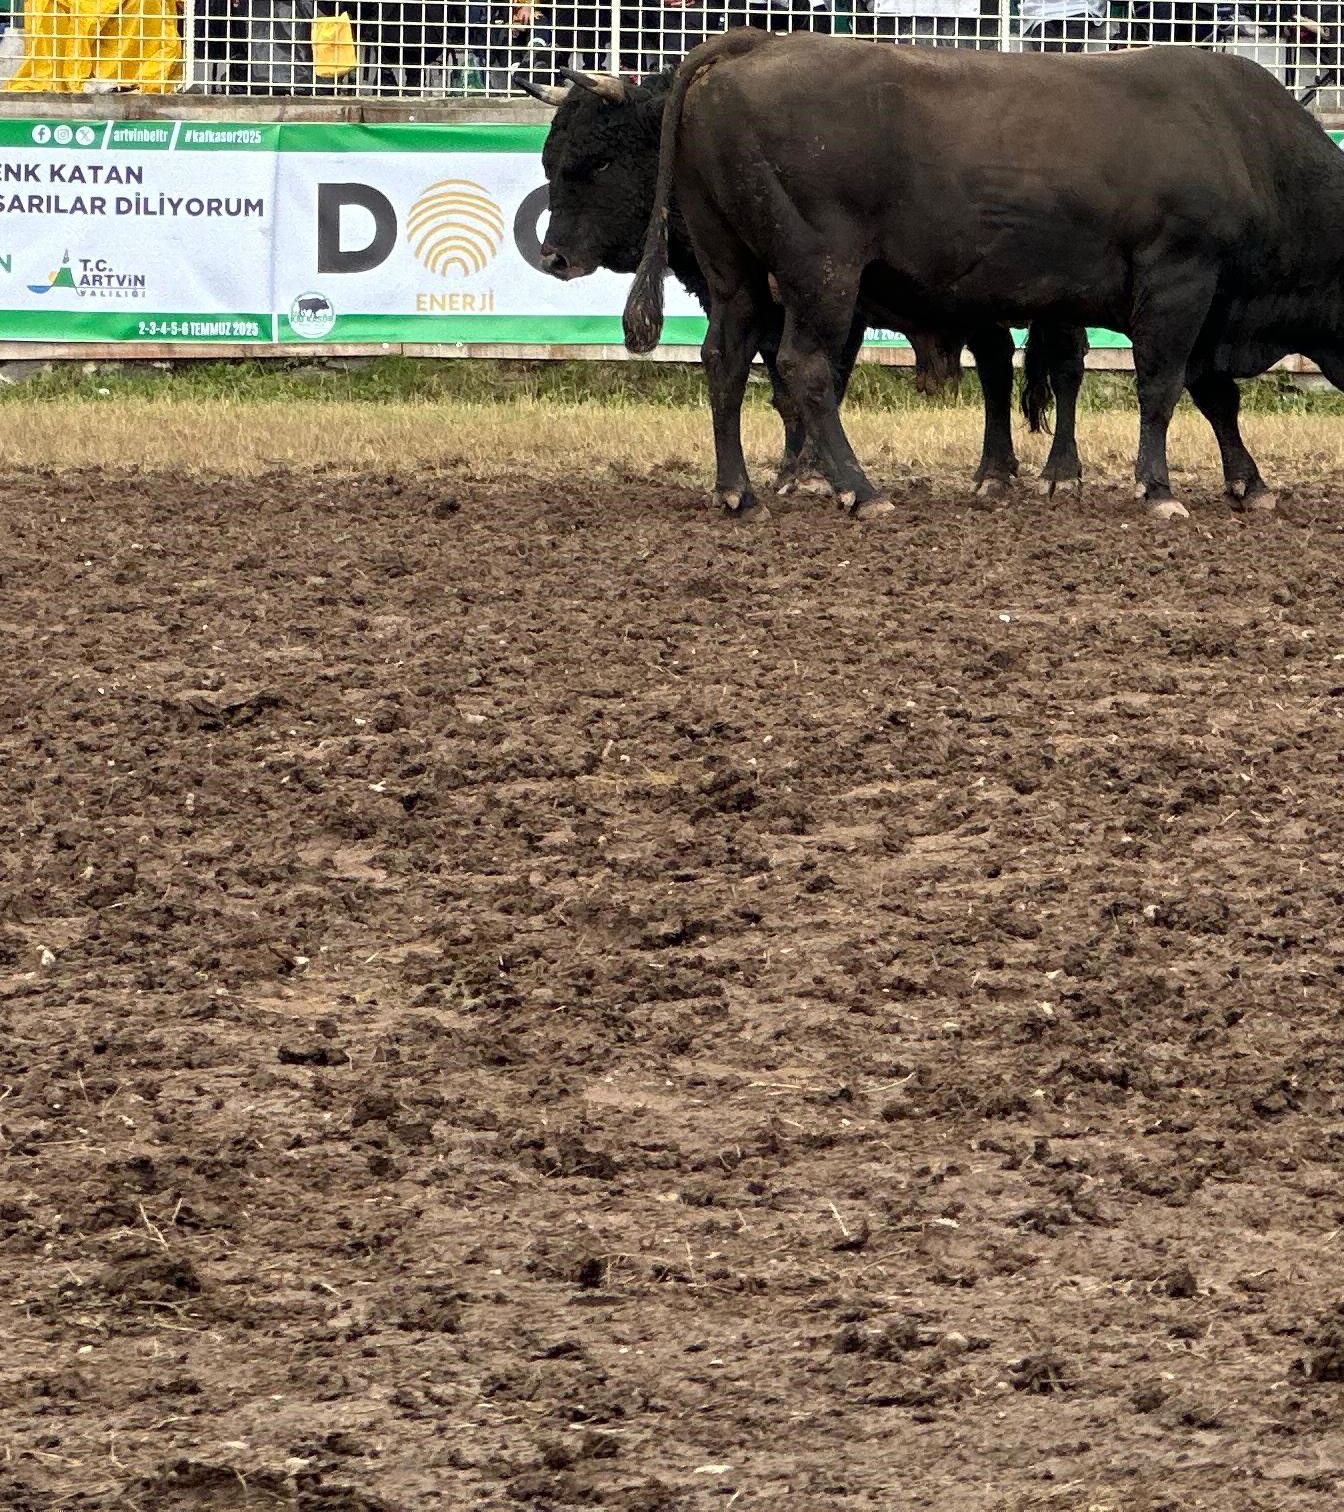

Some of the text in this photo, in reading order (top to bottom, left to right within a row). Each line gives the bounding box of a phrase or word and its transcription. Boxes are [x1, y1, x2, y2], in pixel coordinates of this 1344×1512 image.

[50, 164, 144, 185] KATAN
[115, 192, 264, 217] DİLİYORUM
[79, 258, 114, 273] T.C.
[416, 287, 495, 313] ENERJİ
[138, 321, 259, 337] 2-3-4-5-6 TEMMUZ 2025
